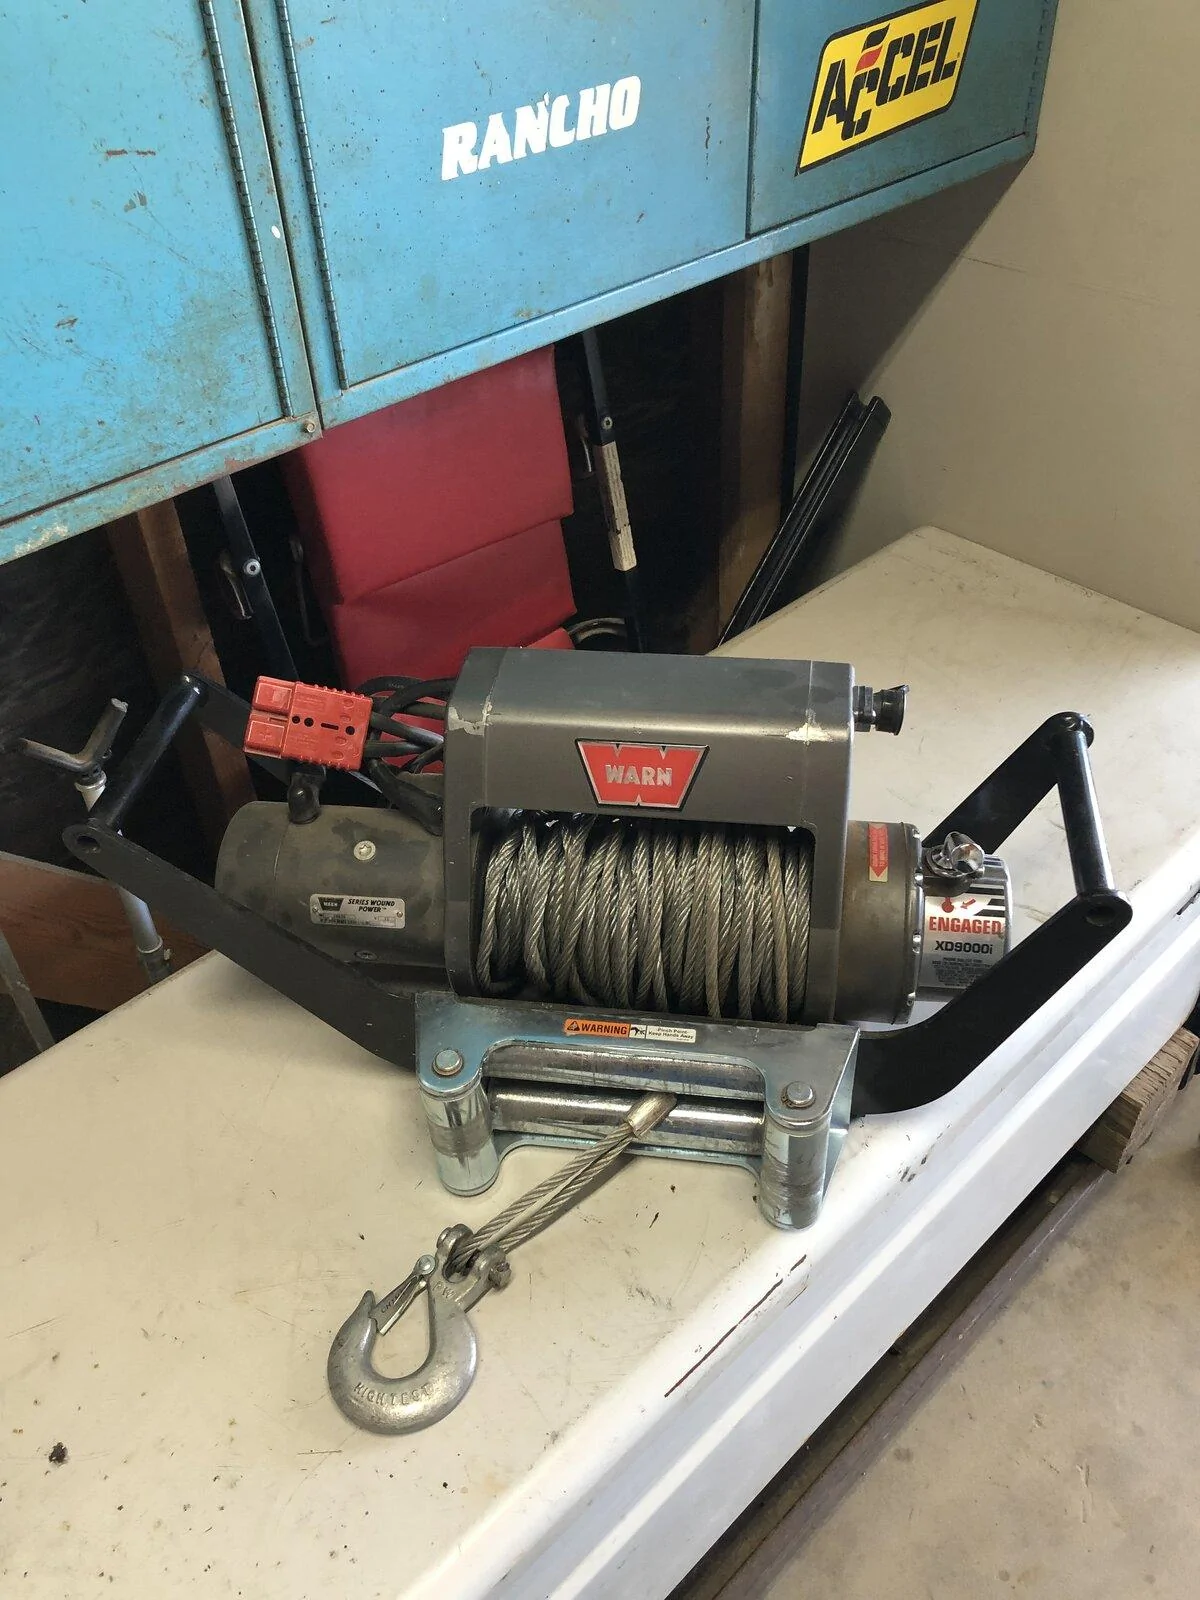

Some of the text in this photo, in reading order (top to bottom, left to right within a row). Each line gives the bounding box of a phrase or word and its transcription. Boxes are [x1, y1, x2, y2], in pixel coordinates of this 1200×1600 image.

[811, 16, 957, 141] ACCEL
[441, 75, 641, 181] RANCHO
[605, 764, 672, 787] WARN
[348, 898, 395, 907] SERIES WOUND
[928, 916, 1004, 935] ENGAGED
[934, 940, 993, 955] XD9000i
[581, 1023, 627, 1035] WARNING
